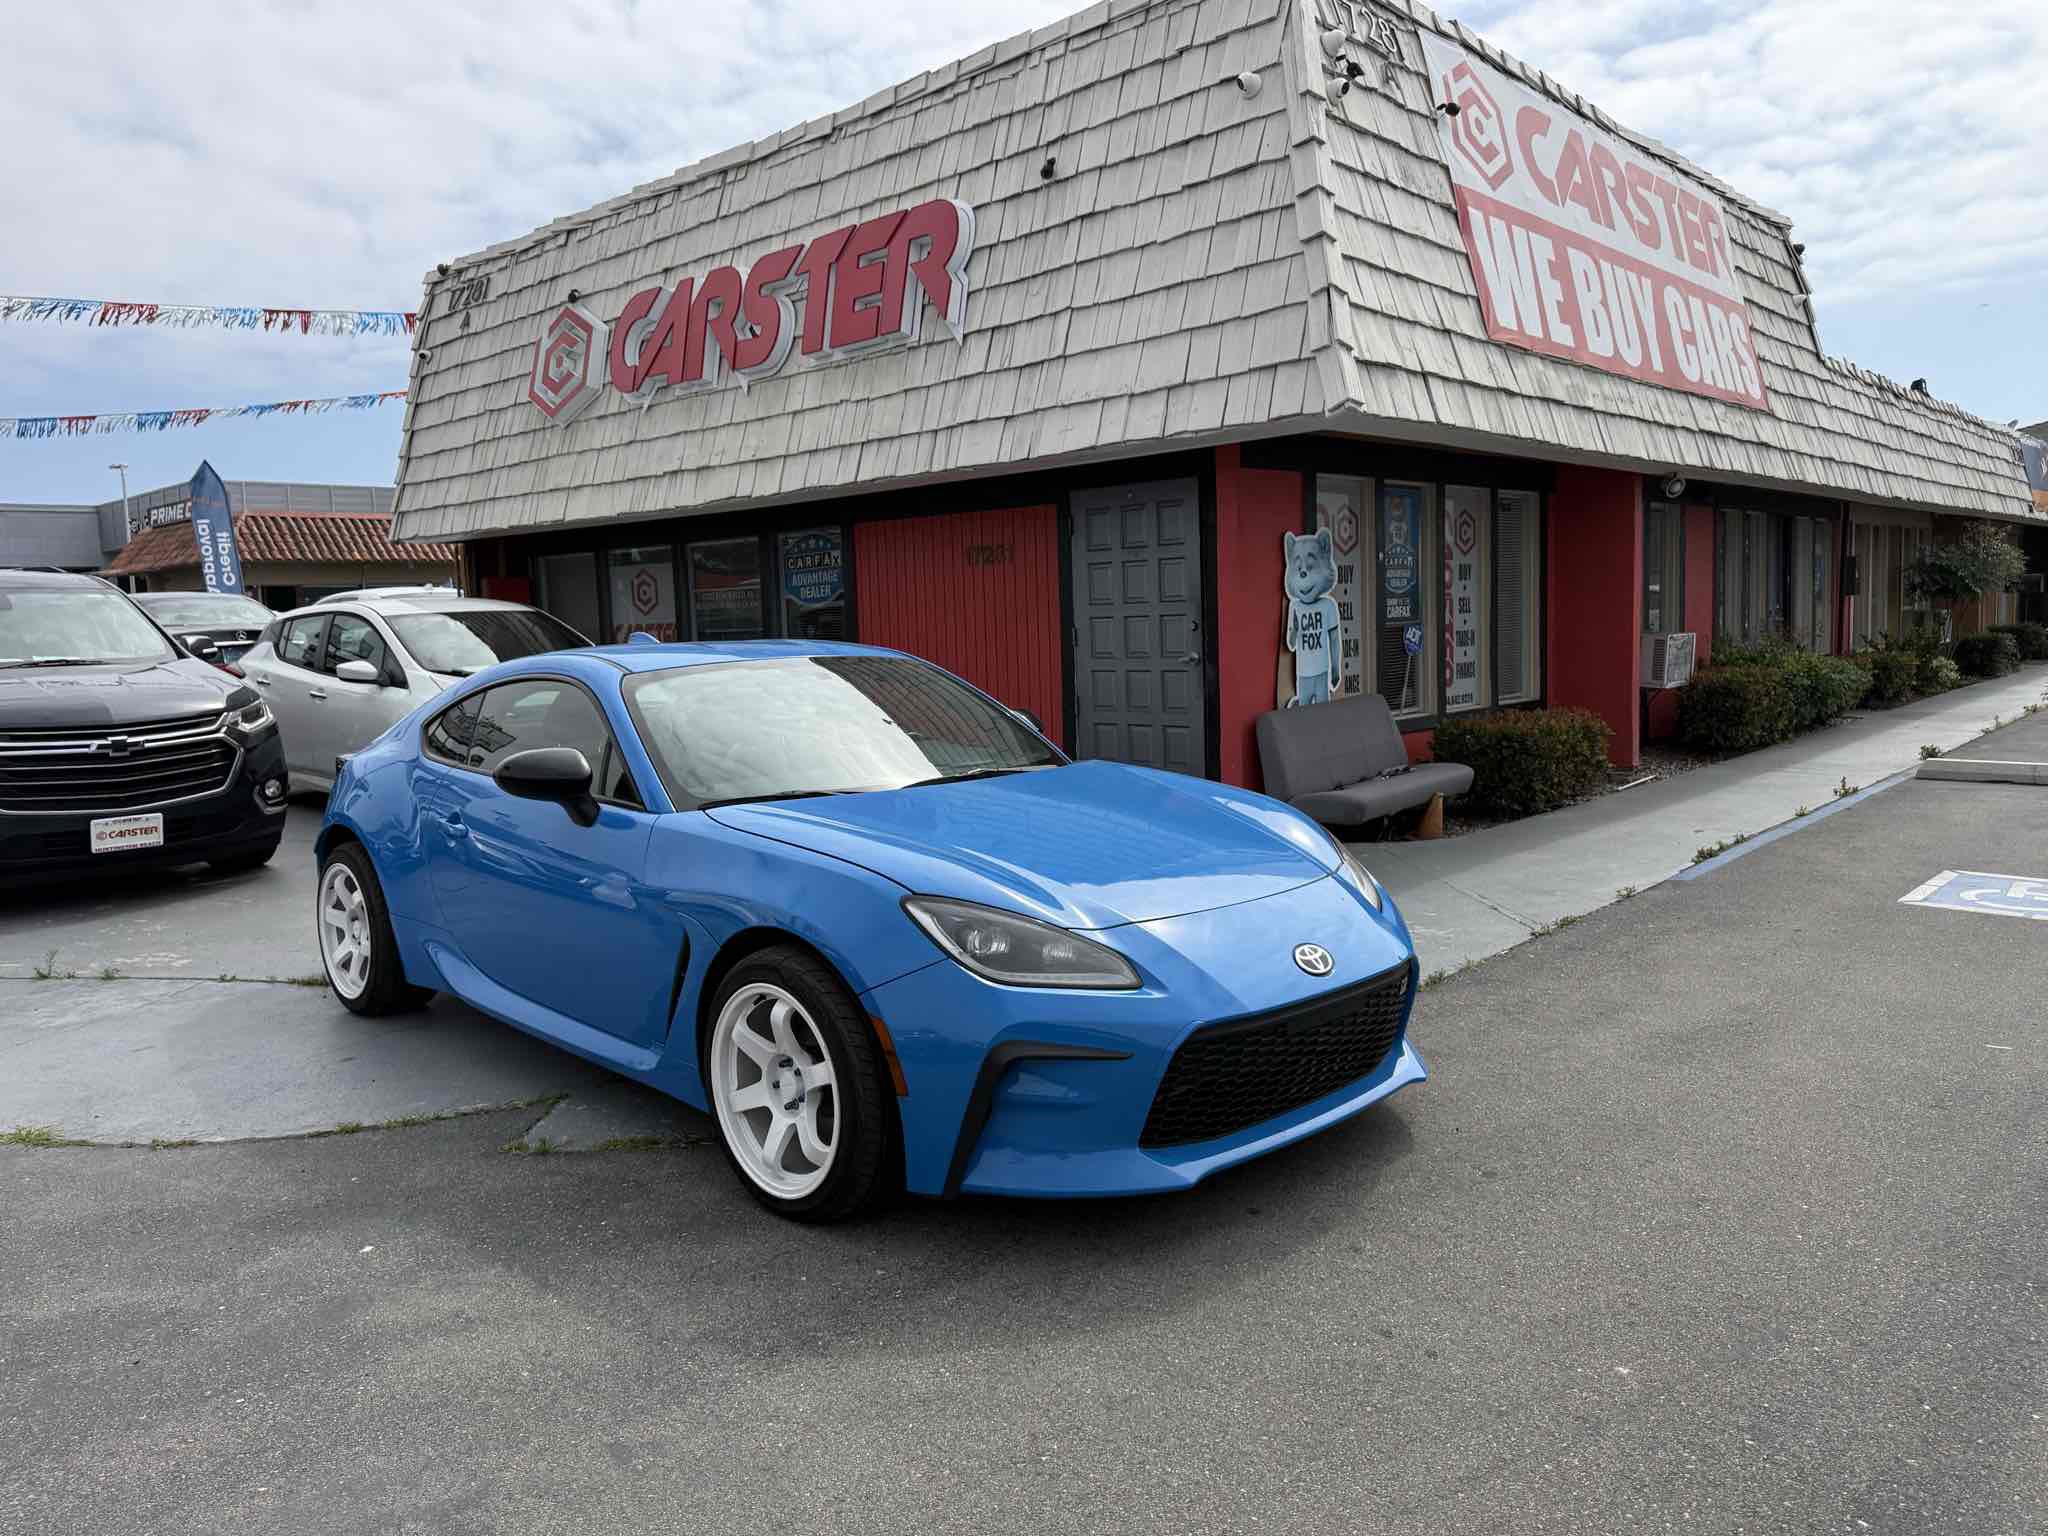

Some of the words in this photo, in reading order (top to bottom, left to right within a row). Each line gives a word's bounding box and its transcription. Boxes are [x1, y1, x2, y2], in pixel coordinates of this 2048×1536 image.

[1515, 105, 1733, 280] CARSTER
[608, 199, 968, 396] CARSTER
[1468, 206, 1574, 348] WE
[1568, 245, 1663, 373] BUY
[1664, 285, 1762, 400] CARS
[150, 503, 185, 525] PRIME
[785, 551, 841, 569] CARFAX
[791, 569, 840, 586] ADVANTAGE
[1337, 564, 1354, 585] BUY
[1458, 564, 1471, 581] BUY
[799, 584, 833, 599] DEALER
[1339, 602, 1354, 621] SELL
[1457, 597, 1471, 614] SELL
[1300, 611, 1323, 631] CAR
[1301, 631, 1323, 651] FOX
[1344, 674, 1360, 694] ANCE
[108, 826, 159, 839] CARSTER
